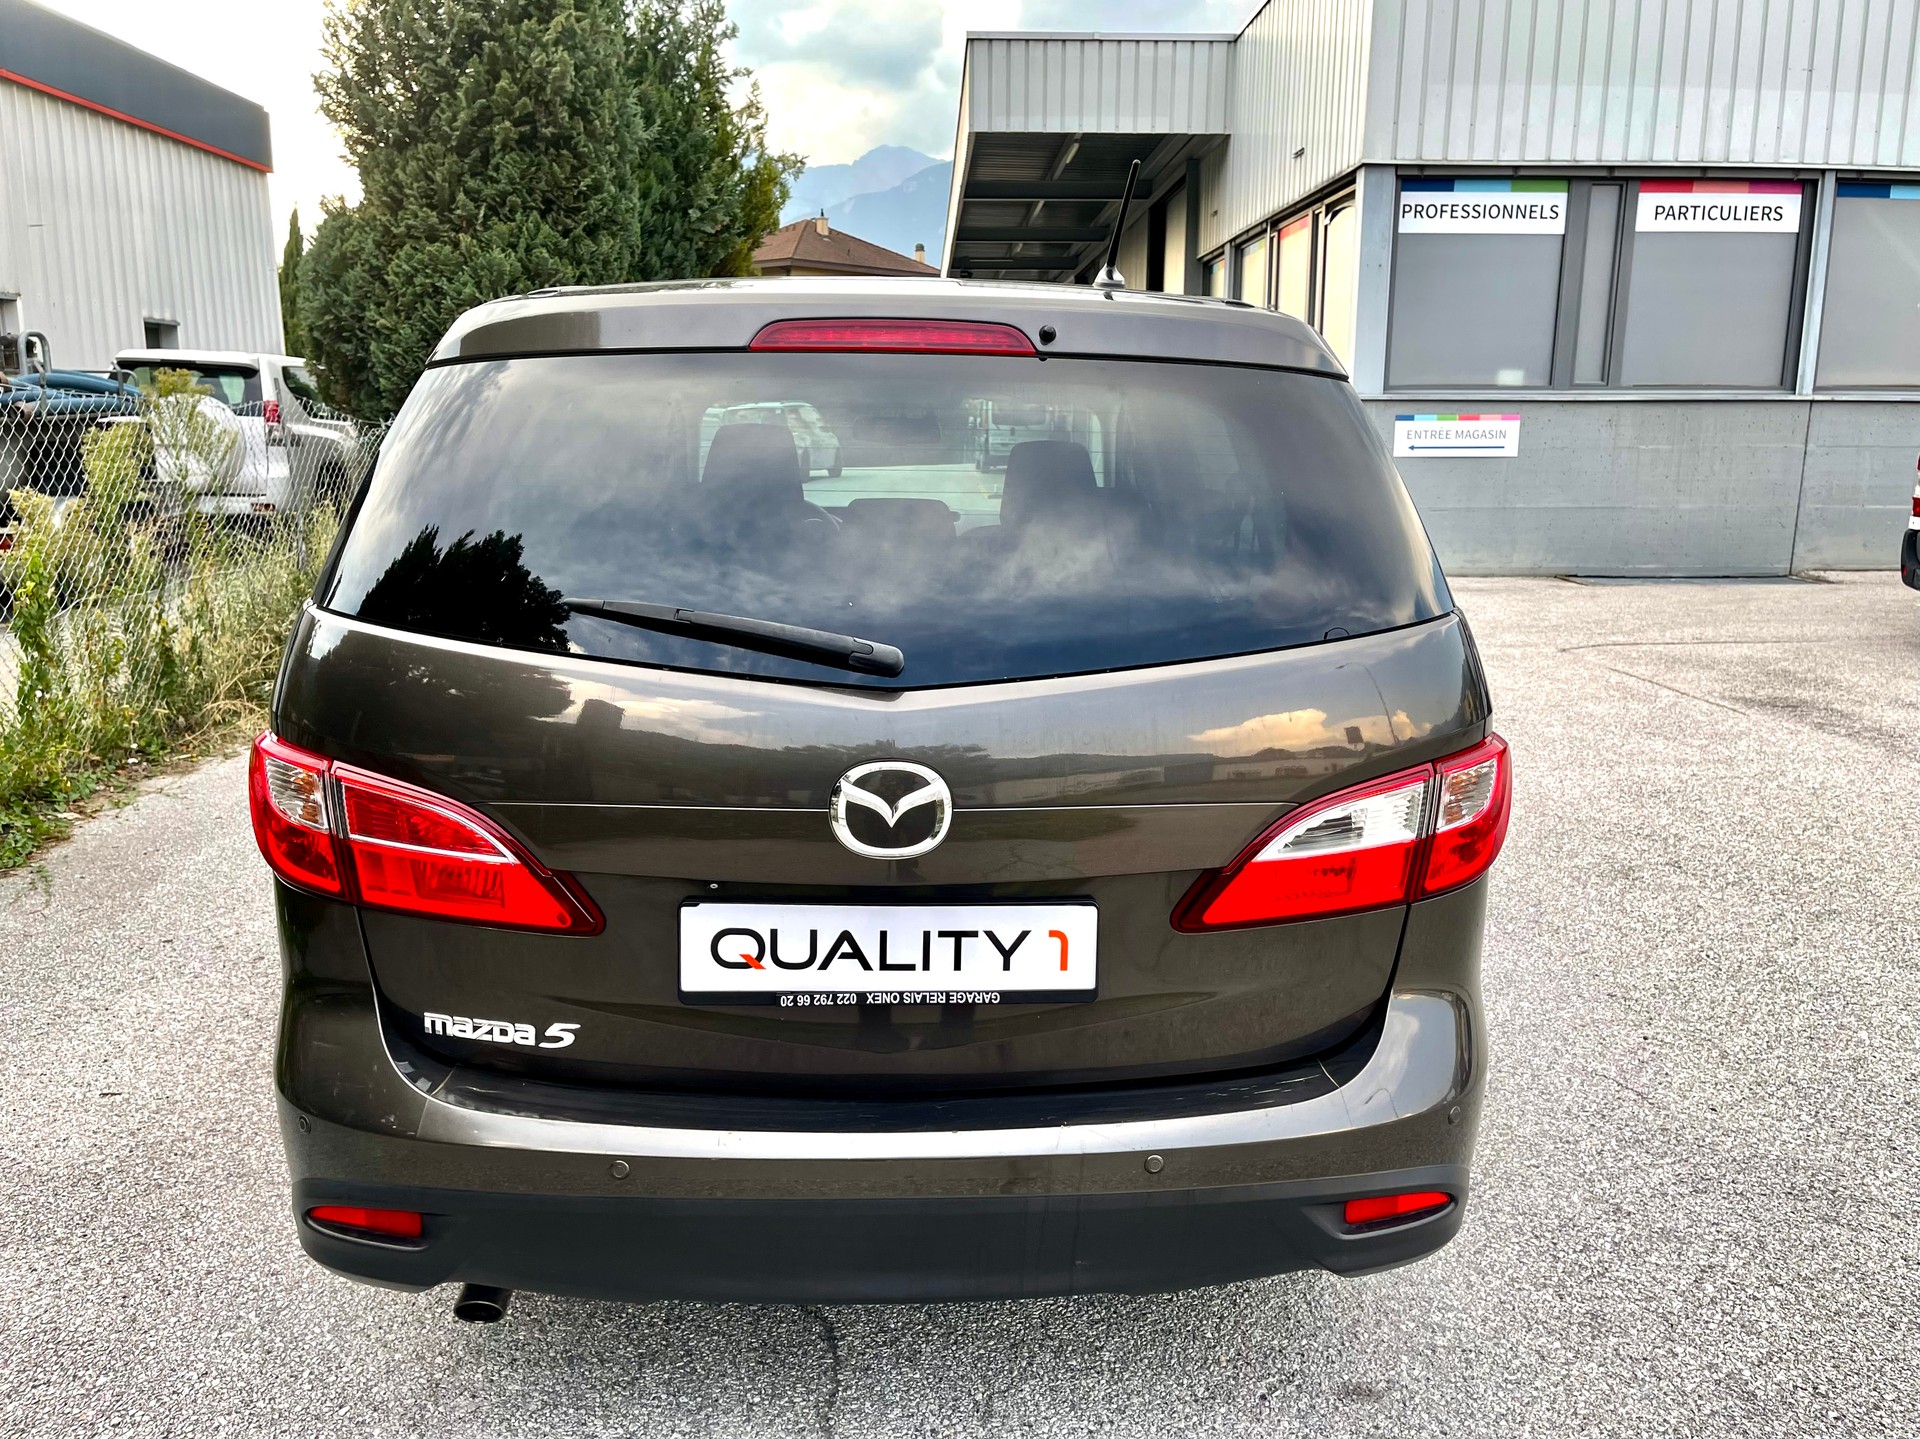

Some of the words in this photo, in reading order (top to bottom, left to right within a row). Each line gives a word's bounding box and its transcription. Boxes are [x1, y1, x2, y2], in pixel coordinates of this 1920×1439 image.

[1401, 203, 1560, 220] PROFESSIONNELS
[1653, 204, 1784, 222] PARTICULIERS
[1406, 427, 1452, 440] ENTRÉE
[1454, 429, 1507, 440] MAGASIN
[709, 927, 1032, 972] QUALITY
[1047, 929, 1069, 972] 1
[780, 995, 794, 1007] 20
[797, 994, 811, 1007] 66
[814, 993, 834, 1006] 792
[836, 993, 857, 1005] 022
[866, 992, 900, 1004] ONEX
[903, 991, 946, 1004] RELAIS
[949, 991, 1001, 1004] GARAGE
[537, 1022, 582, 1049] 5
